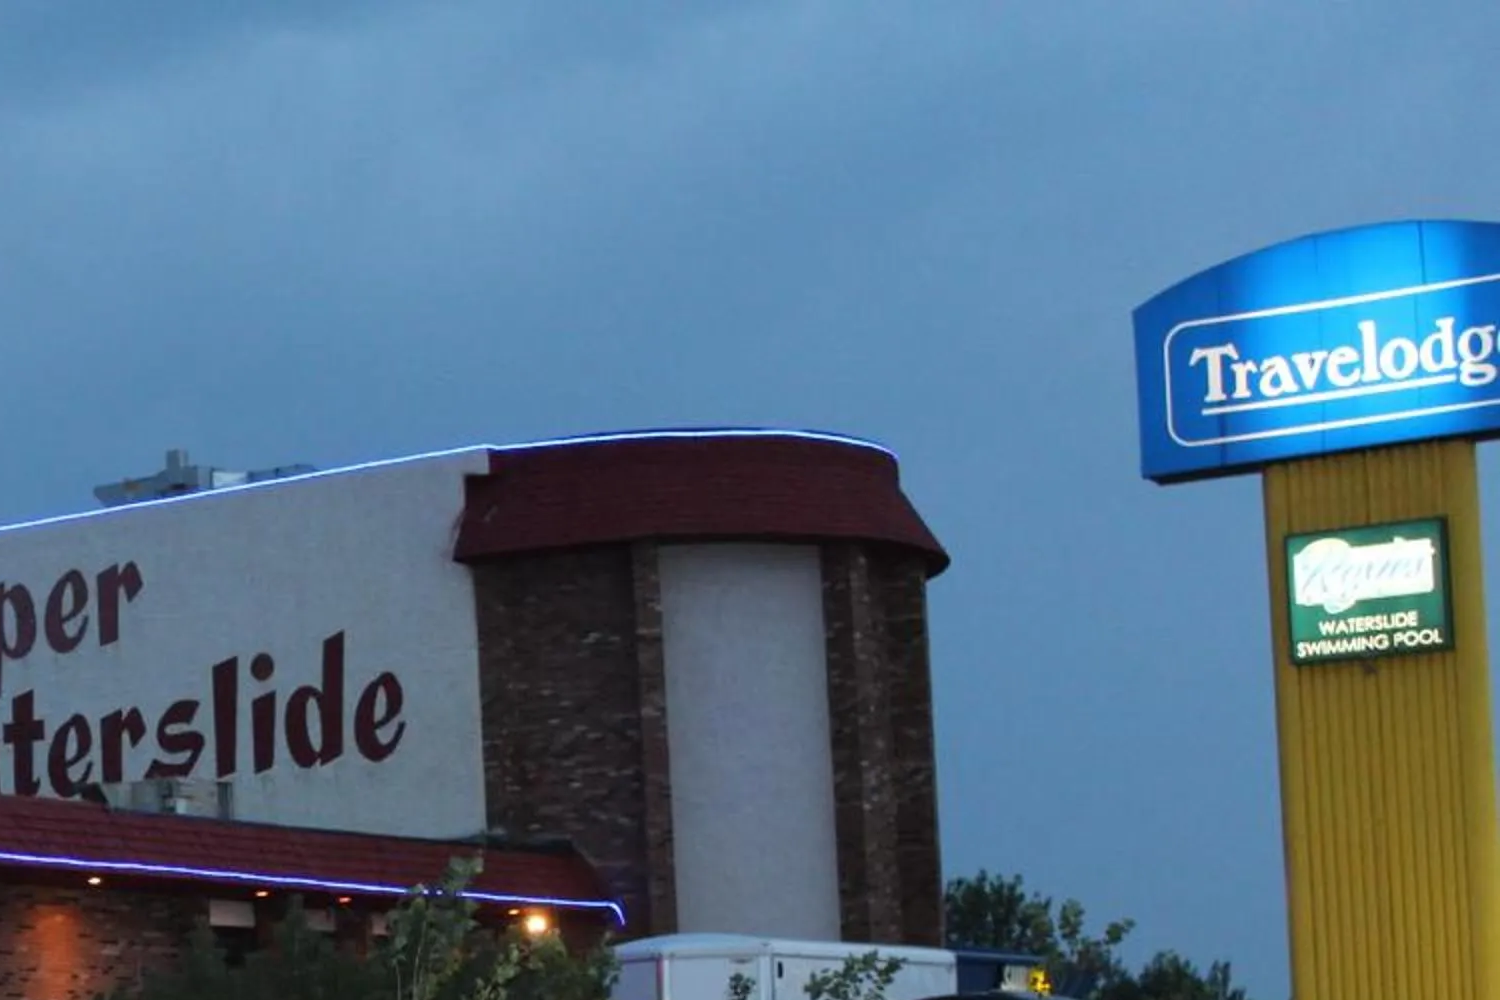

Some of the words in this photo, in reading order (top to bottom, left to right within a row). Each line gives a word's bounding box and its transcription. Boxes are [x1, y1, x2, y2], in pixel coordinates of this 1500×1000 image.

[1188, 316, 1500, 402] Travelodg
[1318, 610, 1418, 636] WATERSLIDE
[1296, 634, 1389, 659] SWIMMING
[1393, 628, 1443, 648] POOL
